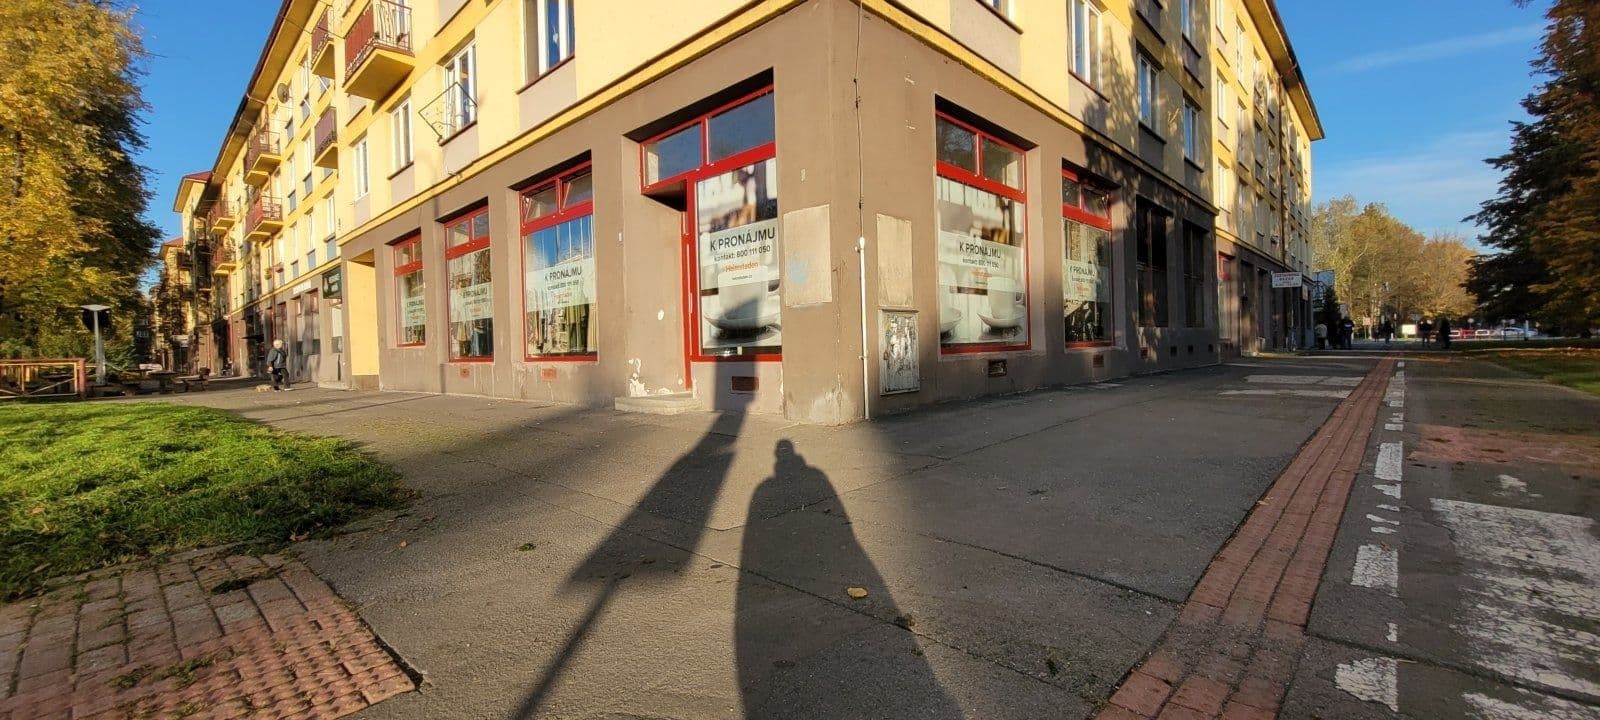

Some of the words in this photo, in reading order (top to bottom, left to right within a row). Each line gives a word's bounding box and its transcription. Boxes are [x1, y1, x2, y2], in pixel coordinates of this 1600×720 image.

[710, 240, 716, 252] K
[718, 226, 775, 250] PRONÁJMU
[749, 247, 757, 256] 111
[758, 245, 771, 254] 050
[960, 241, 965, 252] K
